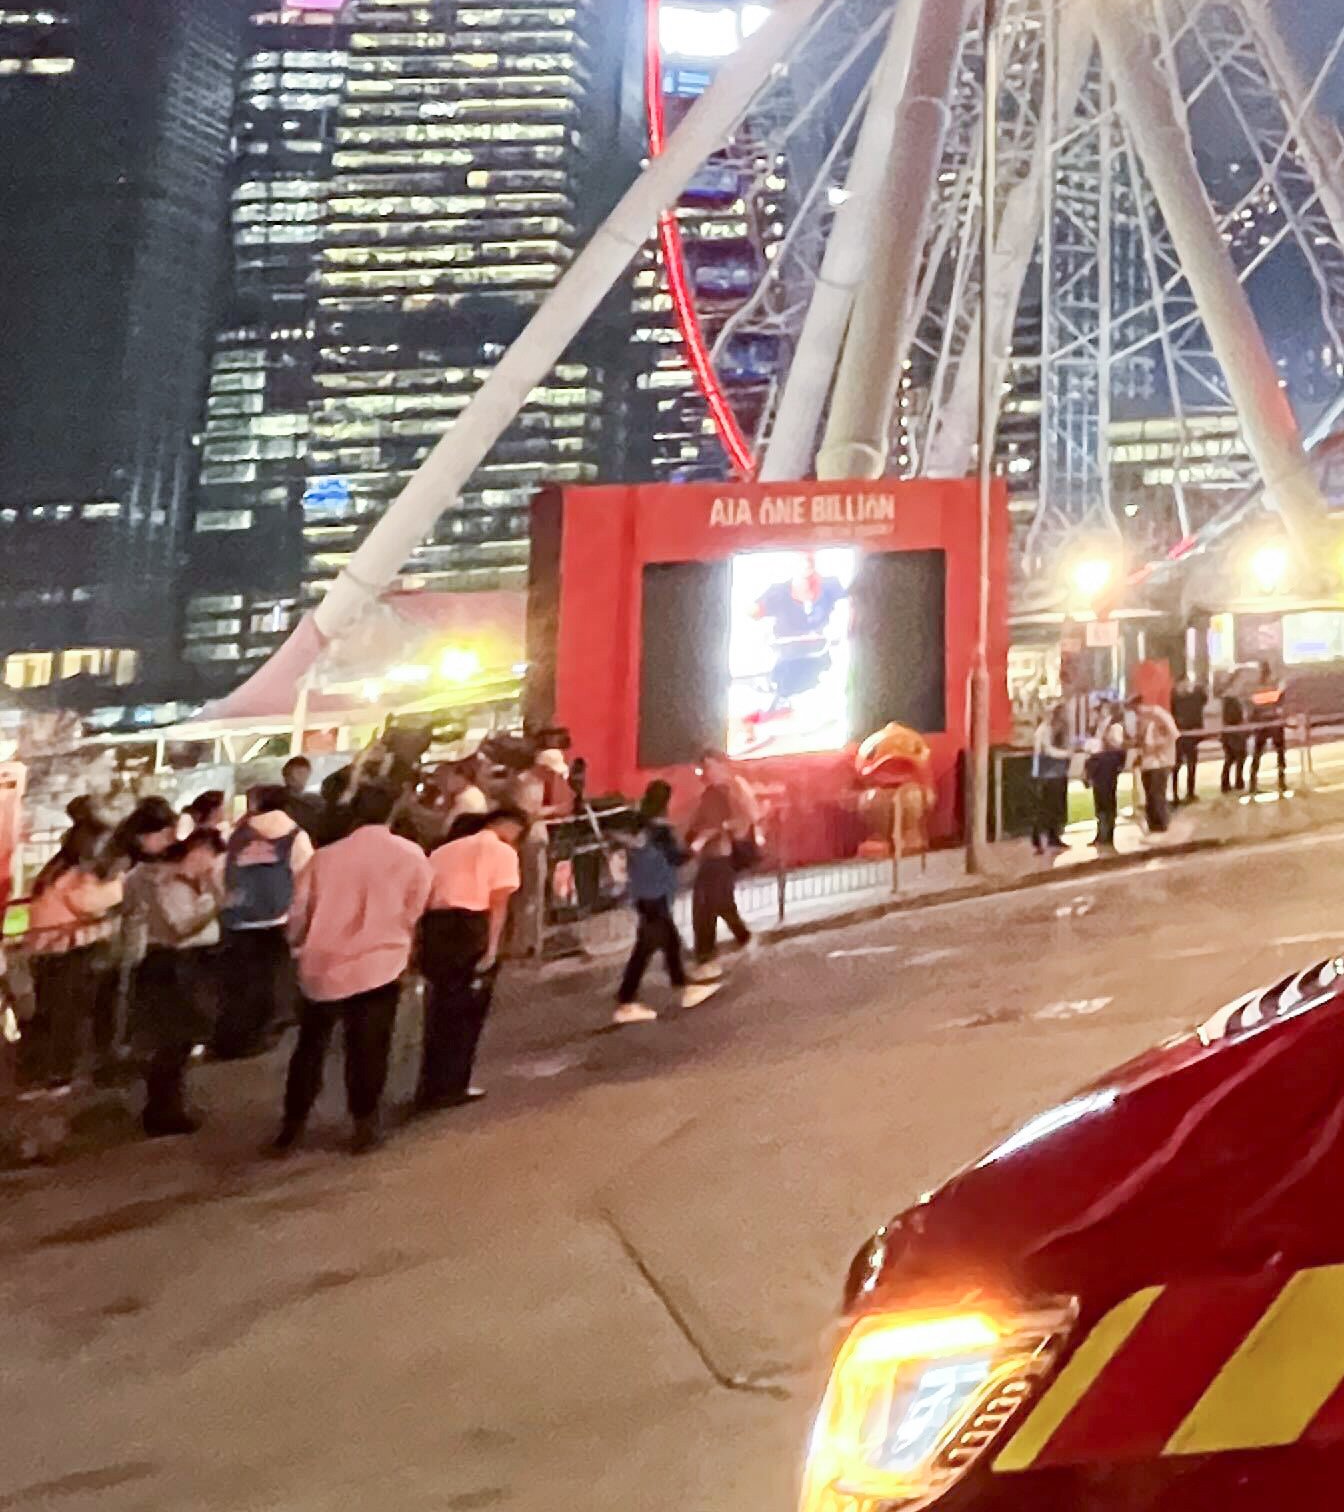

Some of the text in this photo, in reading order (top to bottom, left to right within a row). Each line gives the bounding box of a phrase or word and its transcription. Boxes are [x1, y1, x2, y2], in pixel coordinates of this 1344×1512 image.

[709, 493, 896, 527] AIA ONE BILLION
